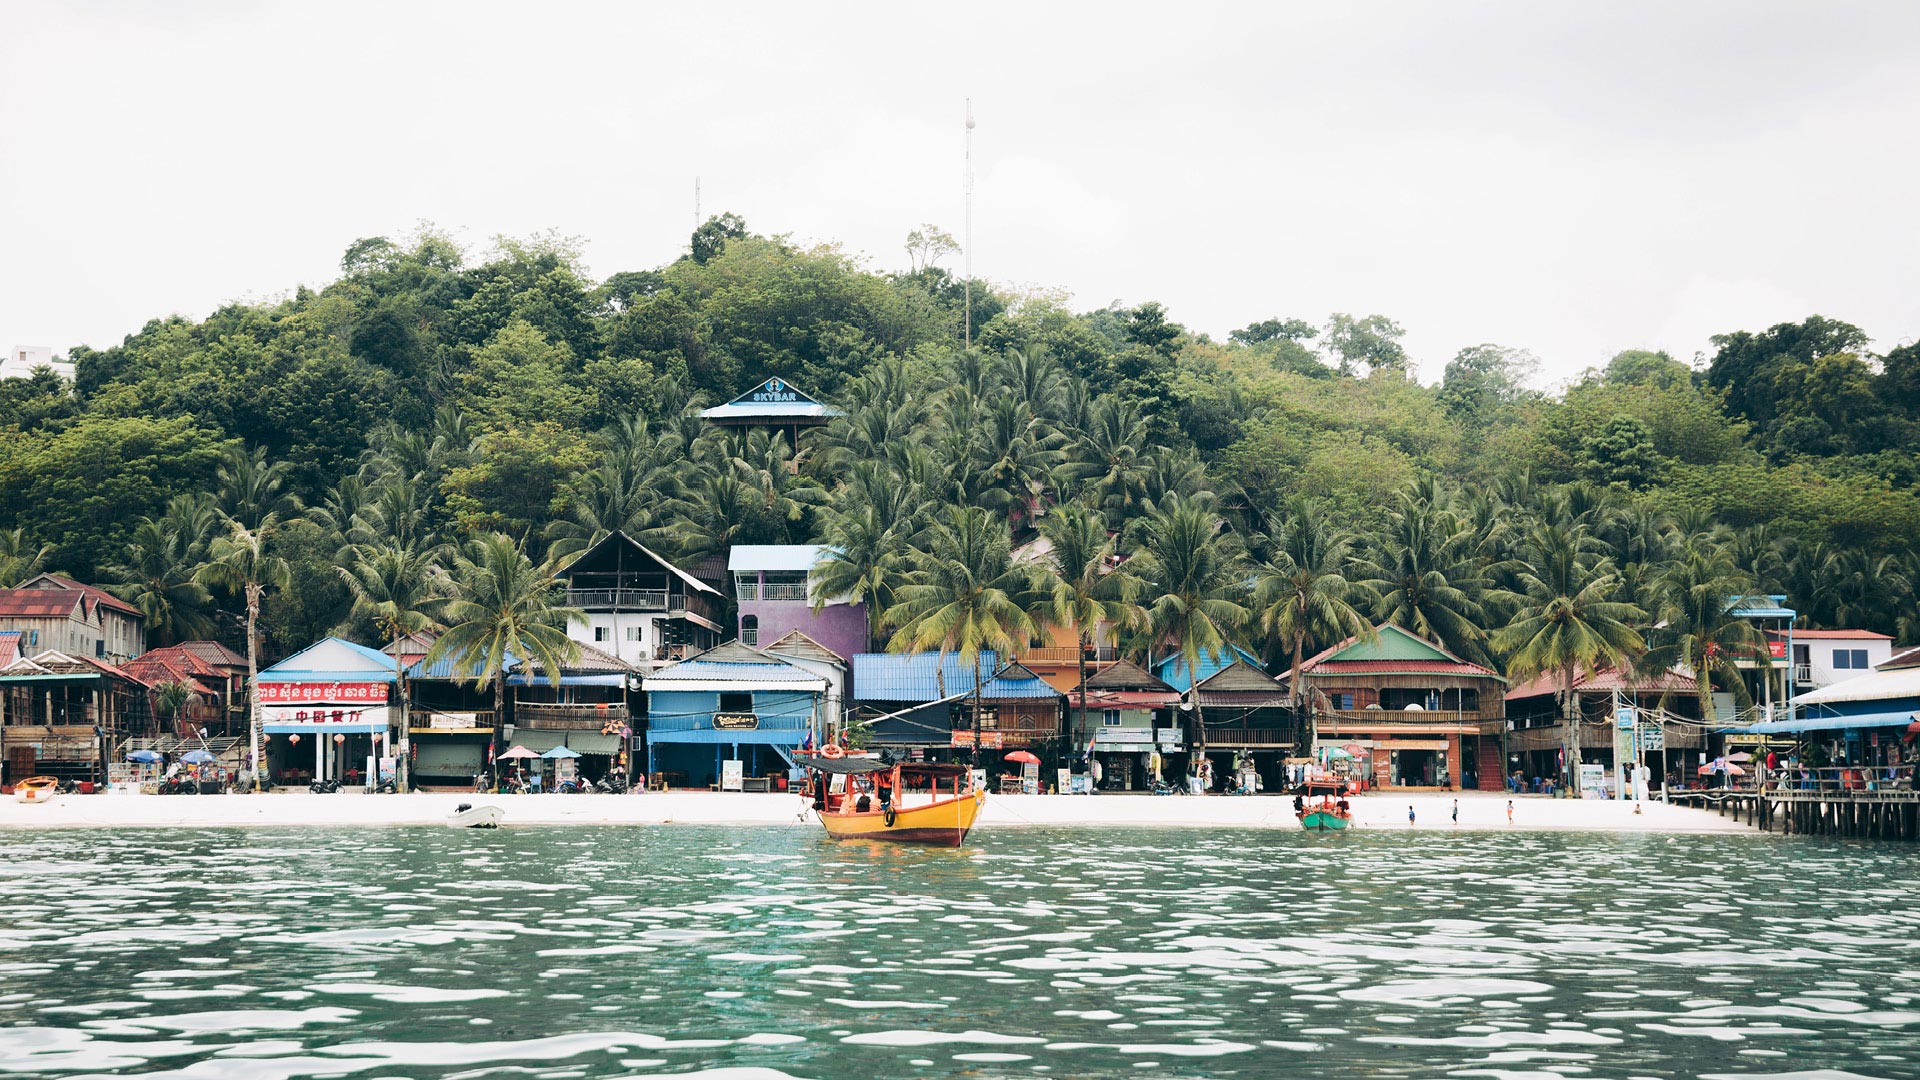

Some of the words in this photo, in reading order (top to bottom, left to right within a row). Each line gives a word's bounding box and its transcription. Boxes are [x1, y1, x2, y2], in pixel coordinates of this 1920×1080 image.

[753, 392, 796, 401] SKYBAR
[296, 710, 362, 723] 中国餐厅
